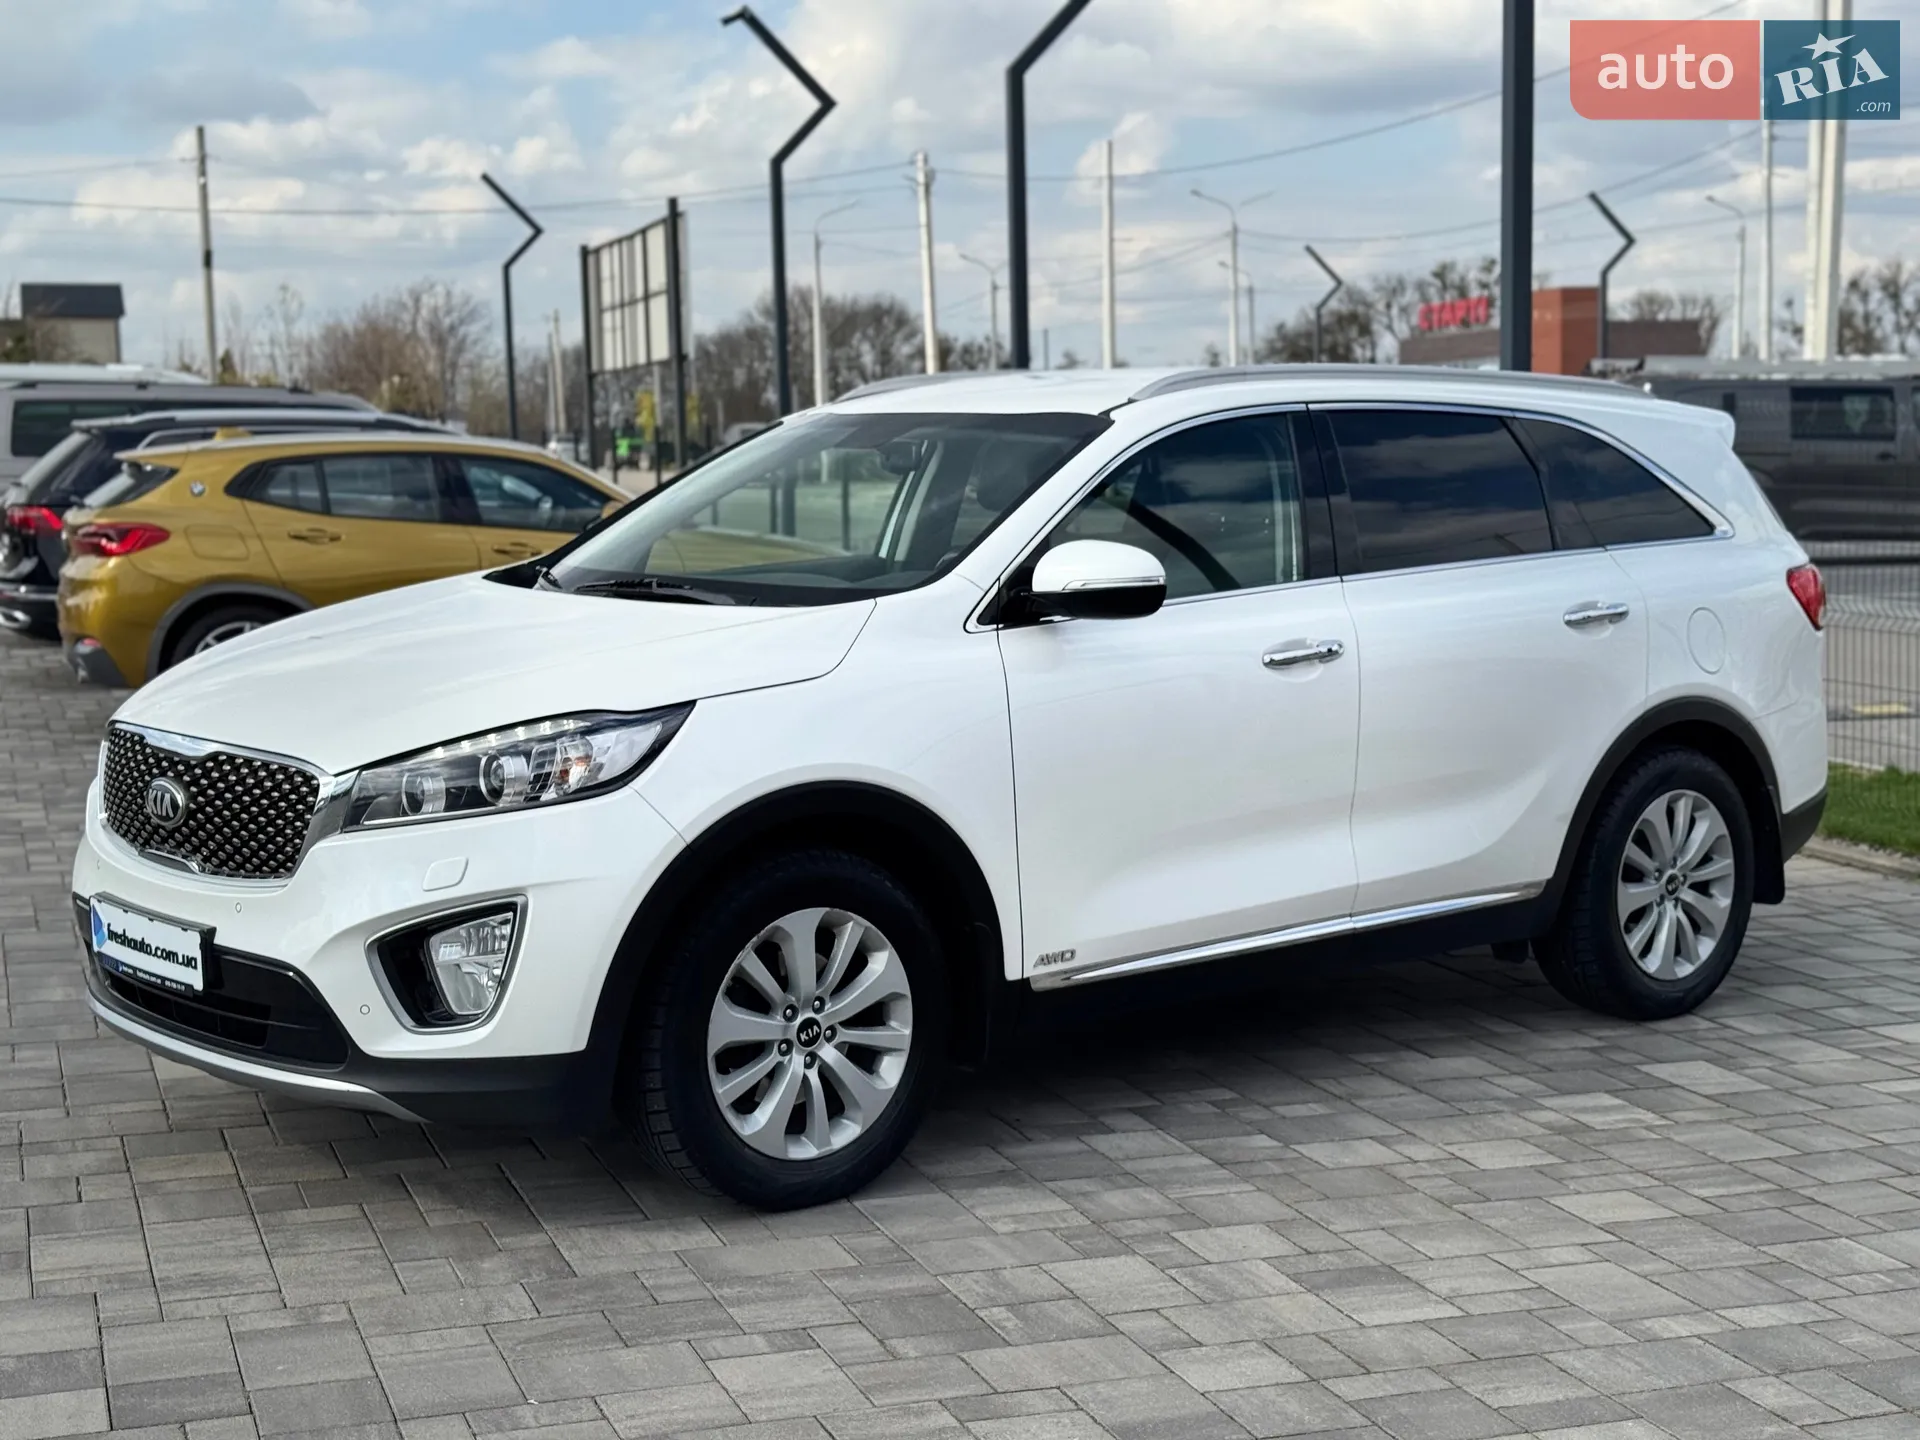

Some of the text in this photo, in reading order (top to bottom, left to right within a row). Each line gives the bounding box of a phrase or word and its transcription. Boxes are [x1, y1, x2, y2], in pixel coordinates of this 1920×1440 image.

[148, 788, 174, 818] KIA
[107, 922, 198, 970] freshauto.com.ua
[1033, 949, 1076, 968] AWD
[800, 1025, 820, 1042] KIA
